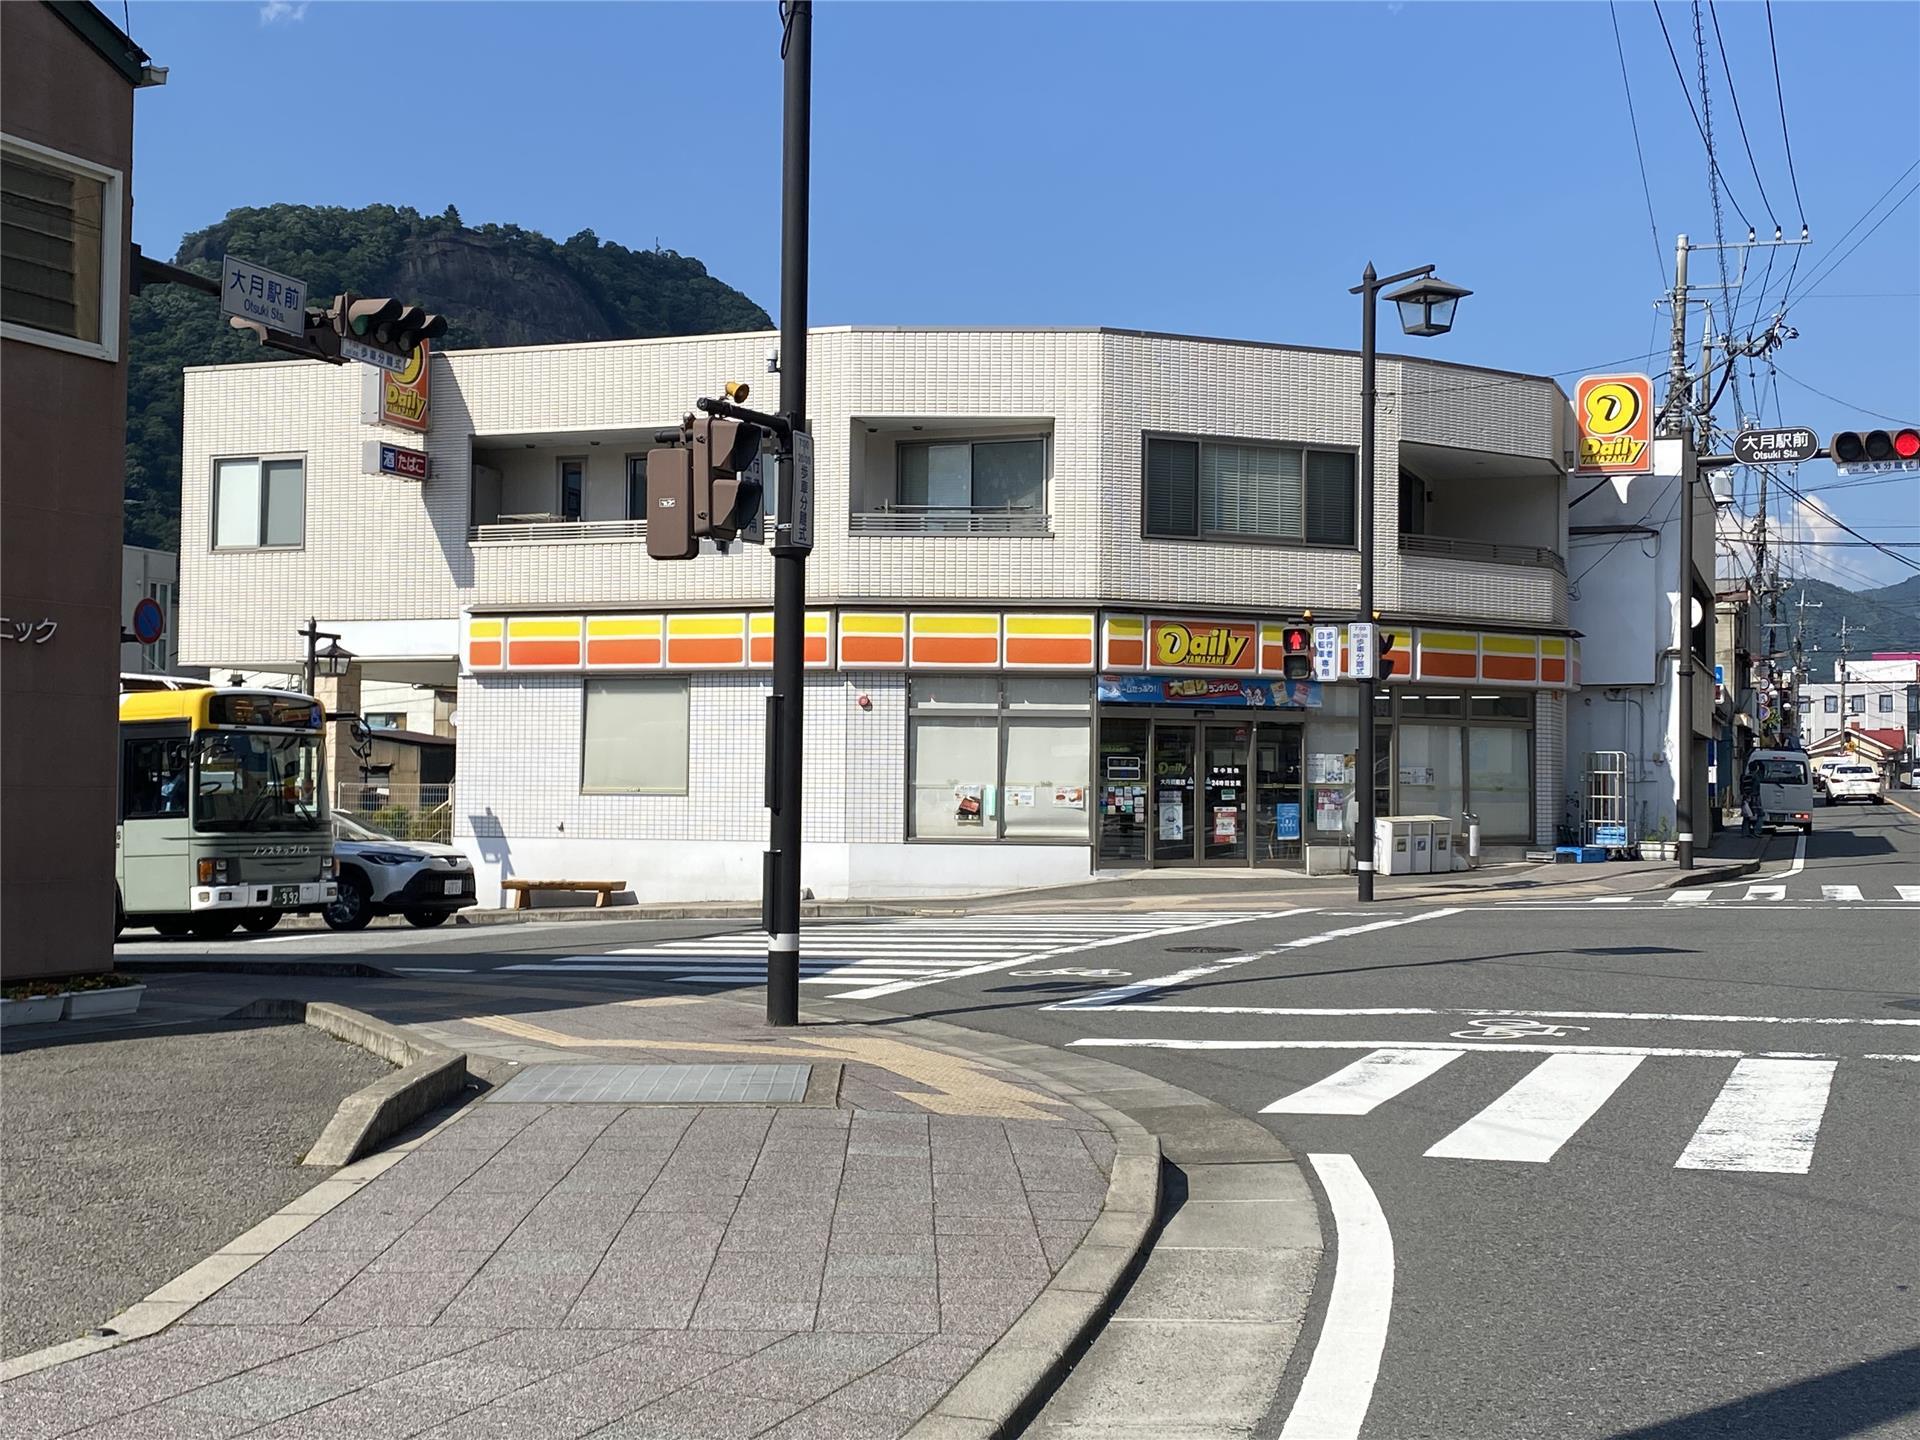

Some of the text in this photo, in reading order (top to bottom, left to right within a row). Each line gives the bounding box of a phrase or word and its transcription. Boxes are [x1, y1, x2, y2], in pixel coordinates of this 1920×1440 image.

[230, 269, 299, 311] 大月駅前
[243, 298, 270, 320] Otsuki
[386, 384, 426, 419] Daily
[1742, 432, 1809, 450] 大月駅前
[1582, 437, 1646, 464] Daily
[1753, 449, 1800, 460] Otsuki Sta.
[383, 450, 424, 474] 酒 たばこ
[1583, 455, 1628, 465] YAMAZAKI
[1157, 623, 1250, 665] Daily
[1186, 654, 1225, 665] YAMAZAKI
[1158, 761, 1187, 775] Daily
[252, 845, 311, 857] ノンステップバス
[282, 891, 299, 905] 992
